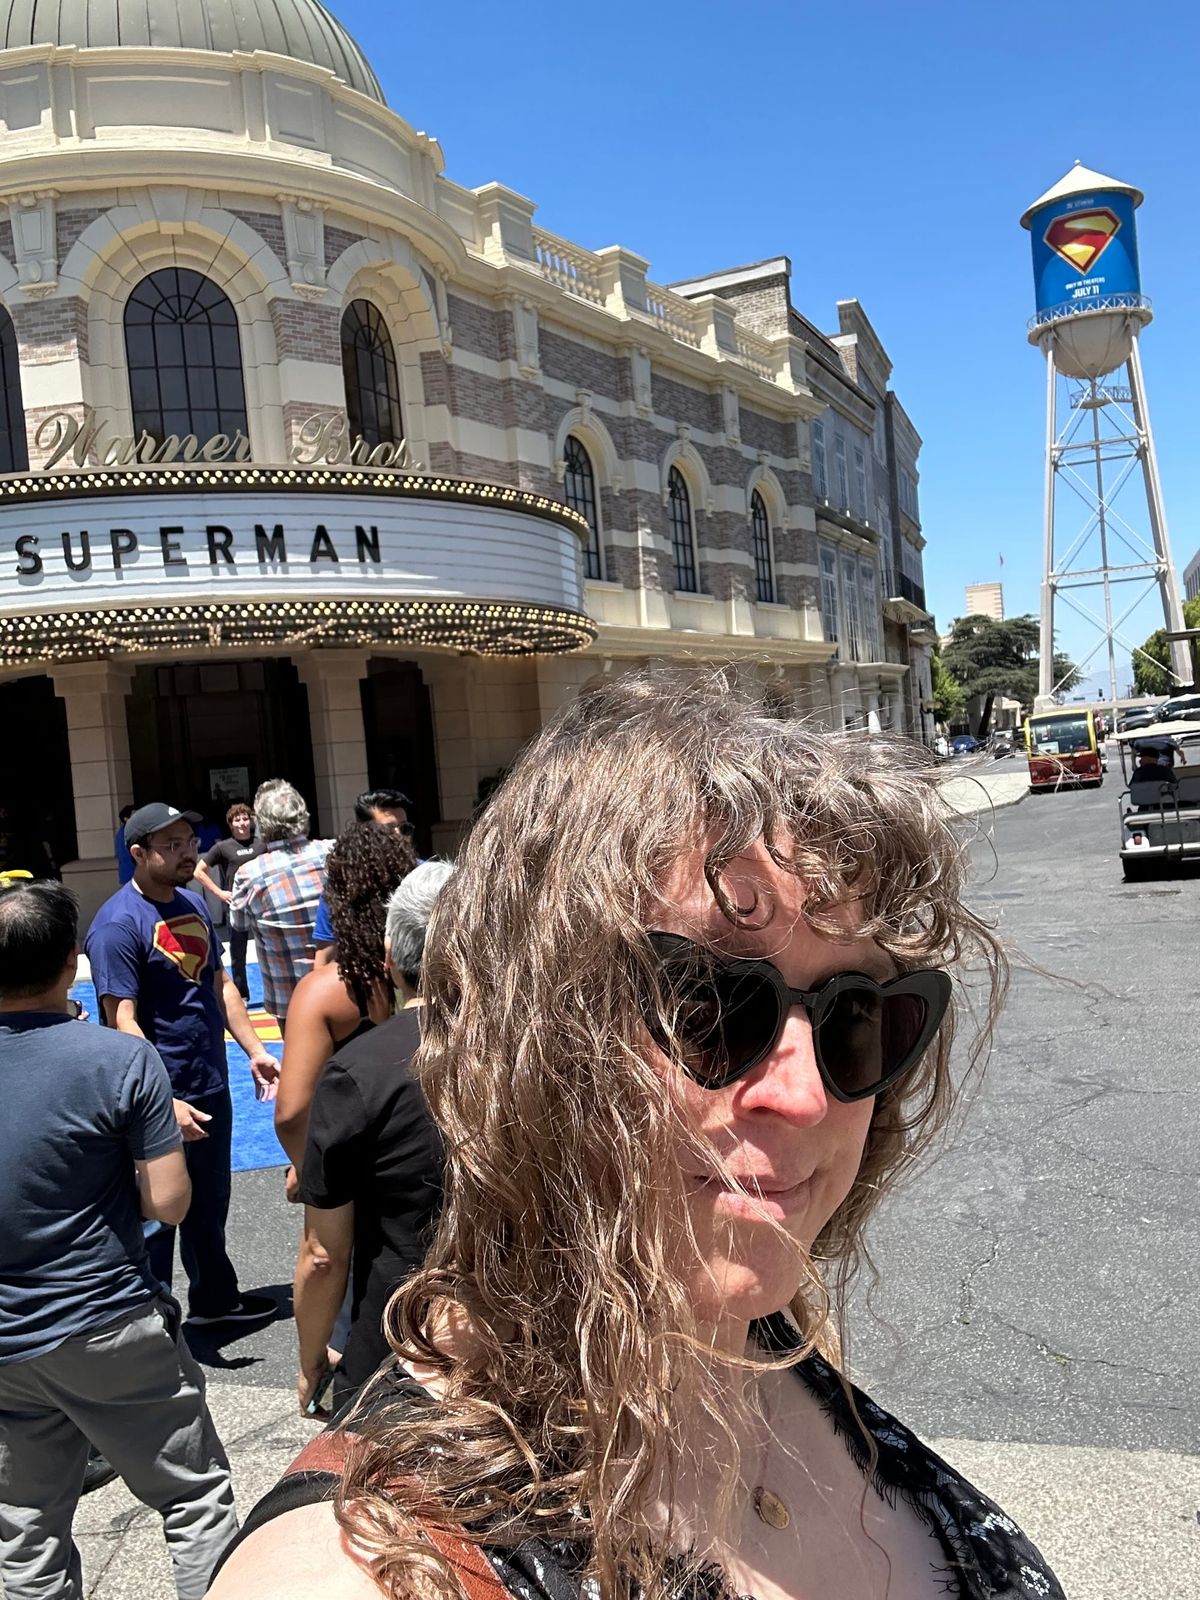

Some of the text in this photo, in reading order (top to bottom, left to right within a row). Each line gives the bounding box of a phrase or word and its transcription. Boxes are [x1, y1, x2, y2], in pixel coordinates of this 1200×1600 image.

[1072, 285, 1099, 298] JULY 11
[34, 408, 426, 471] Warner Bros.
[15, 524, 381, 576] SUPERMAN
